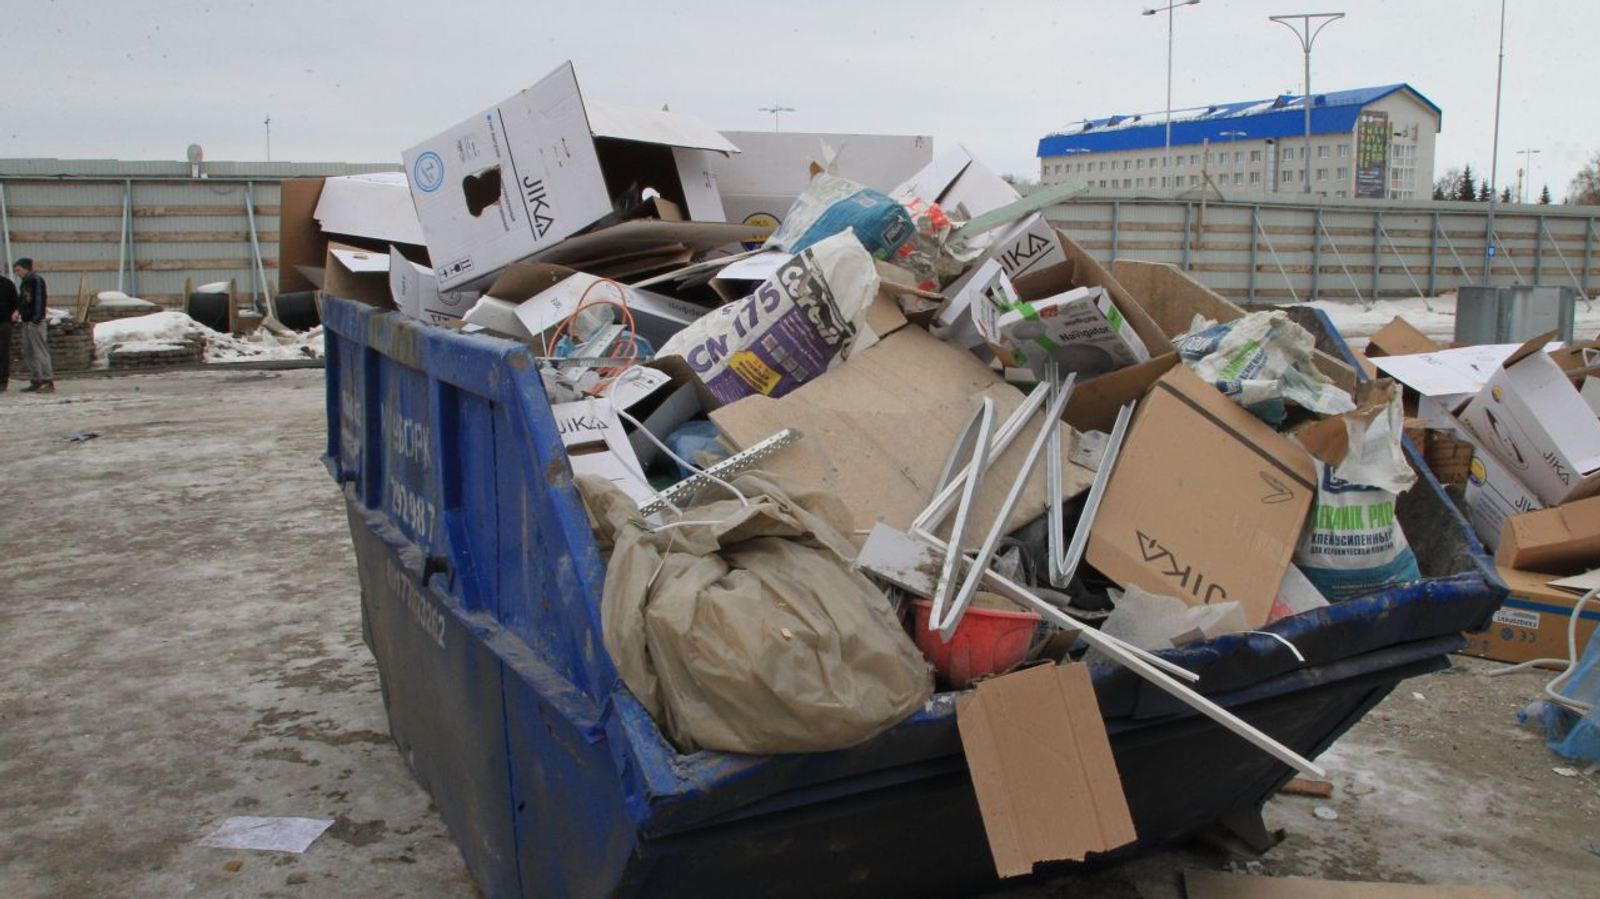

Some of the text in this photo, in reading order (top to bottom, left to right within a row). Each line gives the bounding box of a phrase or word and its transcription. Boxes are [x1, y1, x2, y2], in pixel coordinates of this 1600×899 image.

[523, 176, 554, 237] JIKA
[687, 333, 730, 374] CN
[732, 281, 781, 339] 175
[559, 416, 609, 434] JIKA
[1543, 451, 1571, 486] JIKA
[1136, 530, 1227, 604] JIKA
